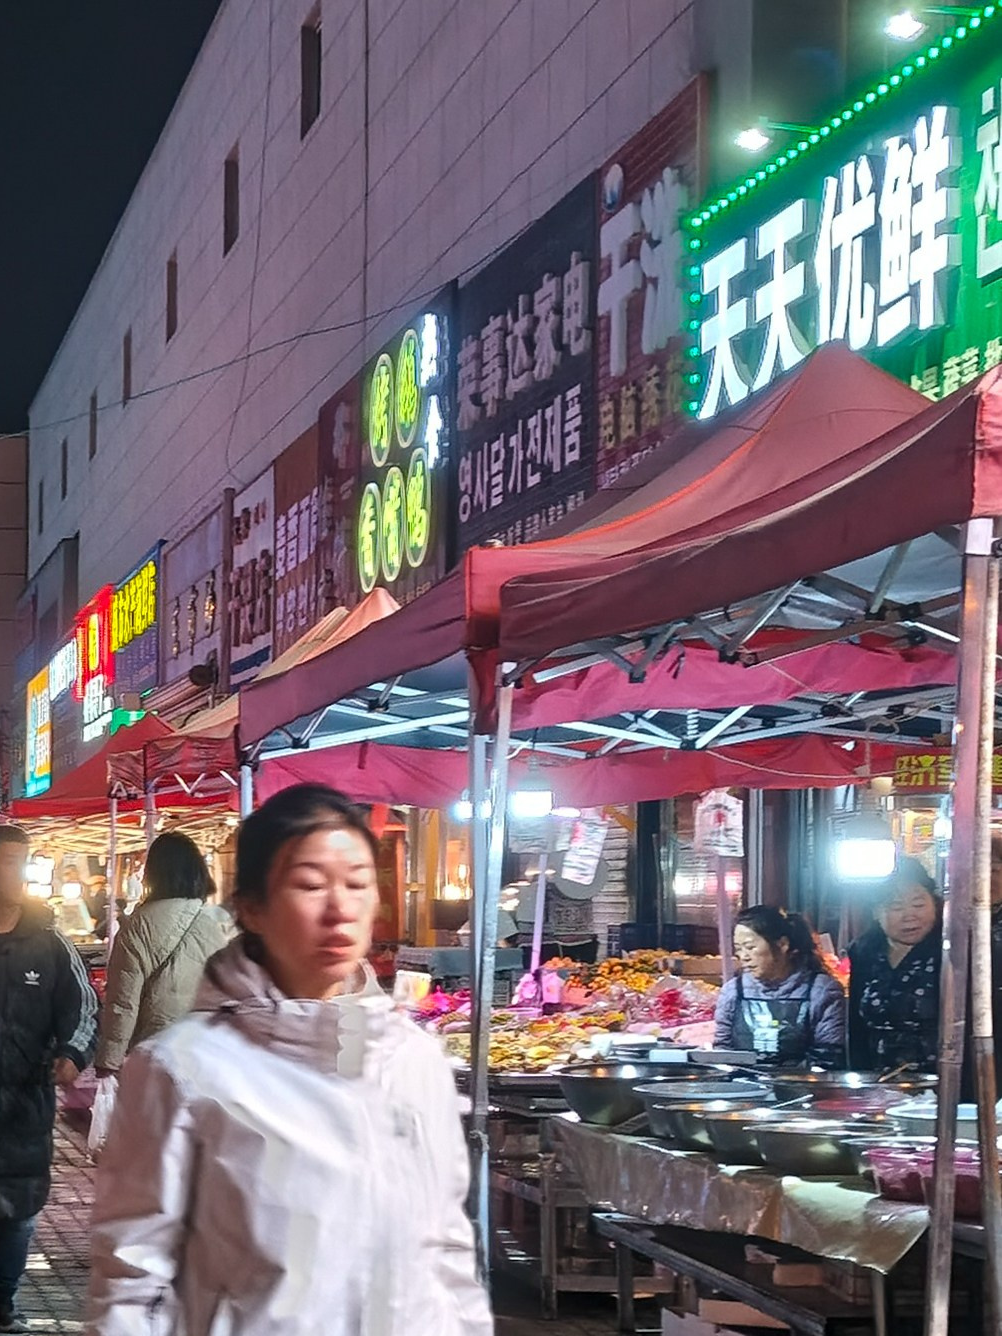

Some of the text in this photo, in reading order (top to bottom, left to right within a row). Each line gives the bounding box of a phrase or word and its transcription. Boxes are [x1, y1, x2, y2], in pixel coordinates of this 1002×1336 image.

[457, 252, 590, 432] 荣事达家电
[698, 106, 951, 419] 天天优鲜
